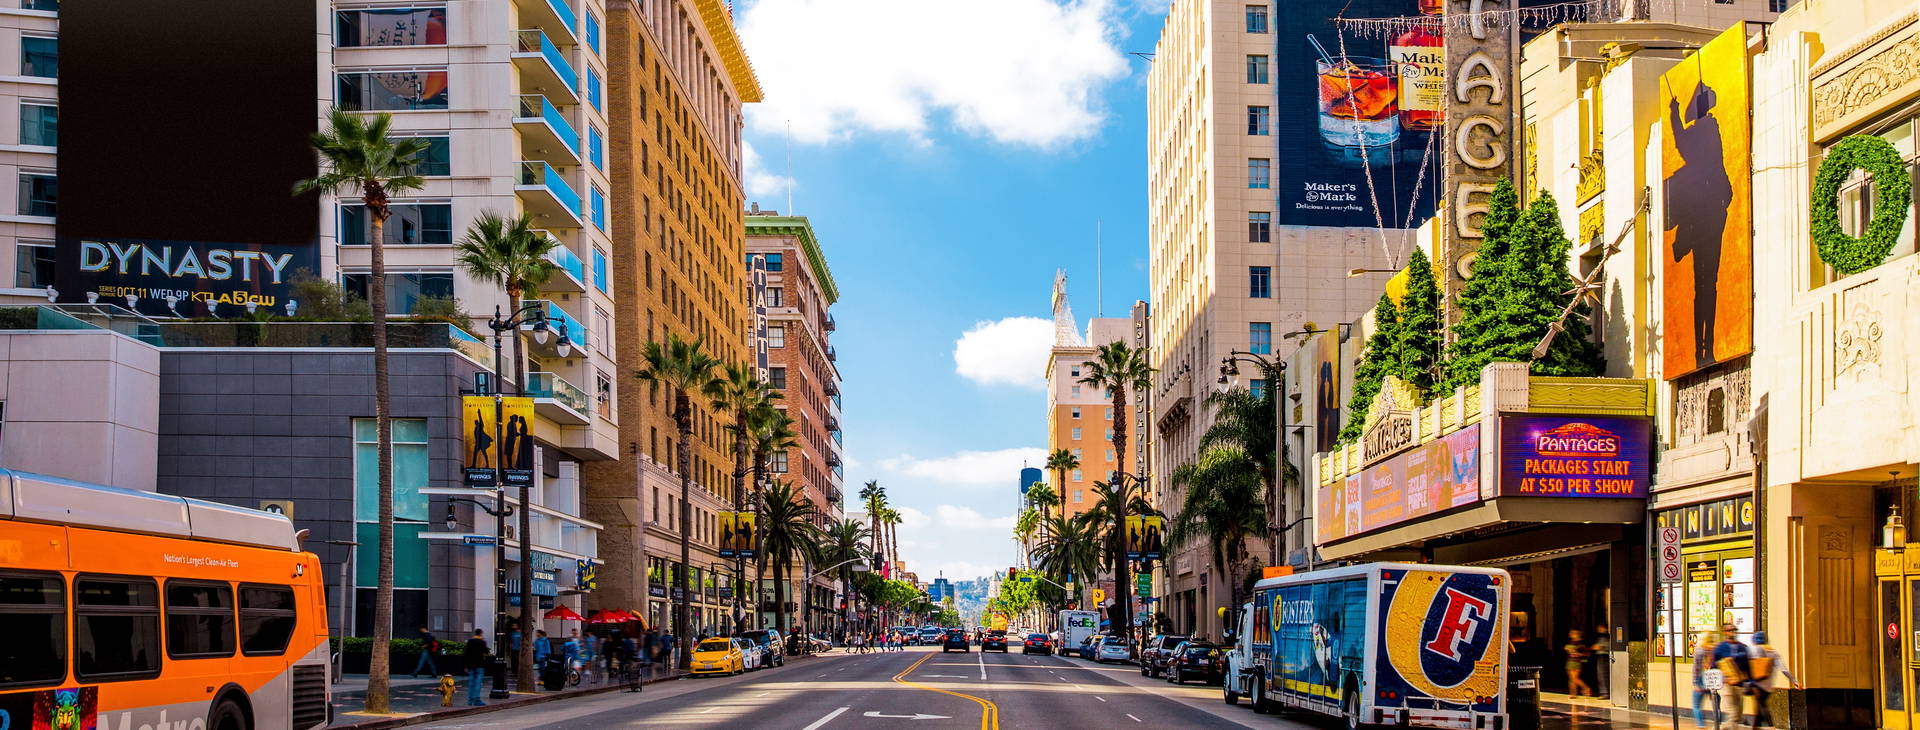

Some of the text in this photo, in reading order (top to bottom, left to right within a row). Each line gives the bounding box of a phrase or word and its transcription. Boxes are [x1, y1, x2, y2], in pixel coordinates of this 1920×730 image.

[1304, 182, 1356, 191] Maker's
[1320, 192, 1357, 201] Mark
[1296, 202, 1324, 210] Delicious
[80, 240, 293, 285] DYNASTY
[117, 287, 189, 301] OCT 11 WED 9P
[754, 268, 768, 354] TAFT
[1363, 417, 1412, 461] PANTAGES
[1538, 436, 1617, 452] PANTAGES
[1525, 459, 1630, 475] PACKAGES START
[1520, 478, 1635, 494] AT $50 PER SHOW
[164, 553, 186, 564] Nation's
[186, 557, 205, 568] Largest
[227, 559, 239, 568] Fleet
[1067, 616, 1096, 628] FedEx
[1425, 586, 1493, 662] F
